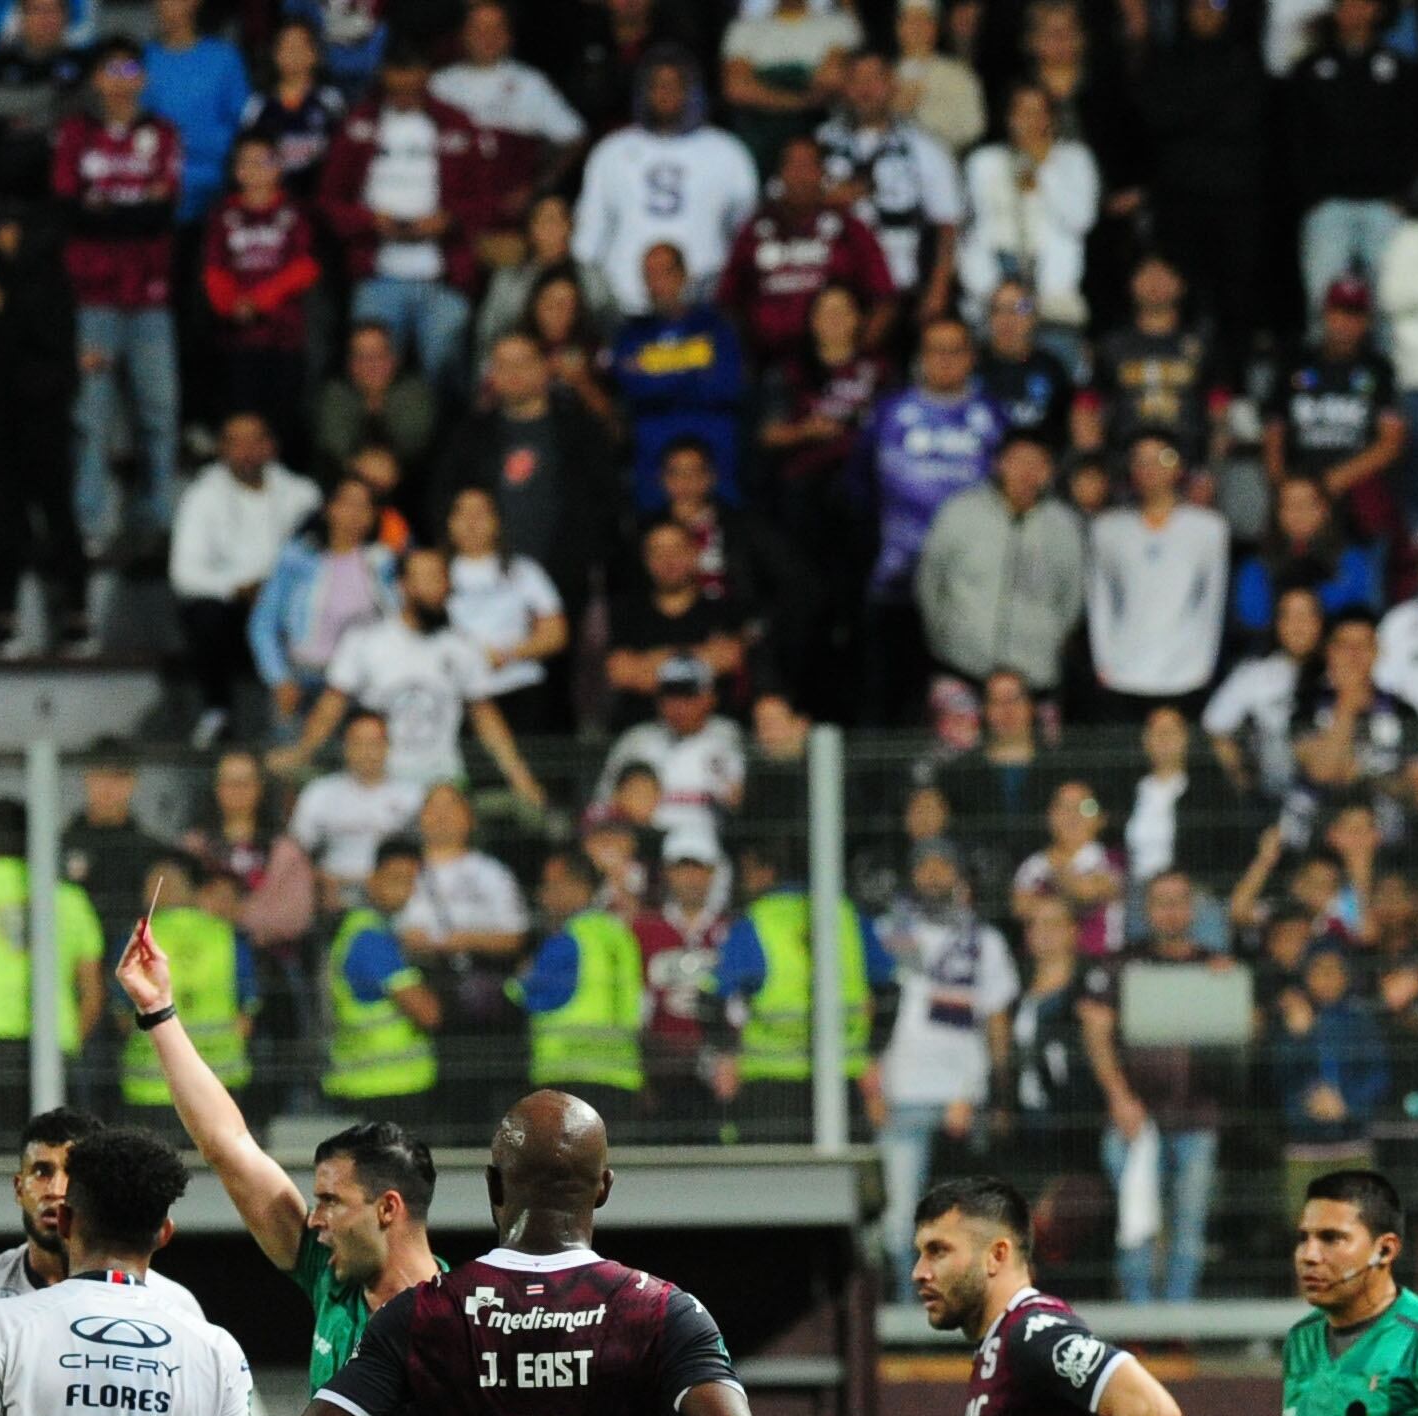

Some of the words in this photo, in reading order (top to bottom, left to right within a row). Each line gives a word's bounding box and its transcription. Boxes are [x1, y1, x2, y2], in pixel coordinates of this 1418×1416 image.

[488, 1303, 607, 1335] medismart
[58, 1353, 181, 1378] CHERY
[479, 1351, 507, 1389] J.
[517, 1350, 594, 1388] EAST
[980, 1336, 1001, 1380] S
[65, 1383, 171, 1413] FLORES
